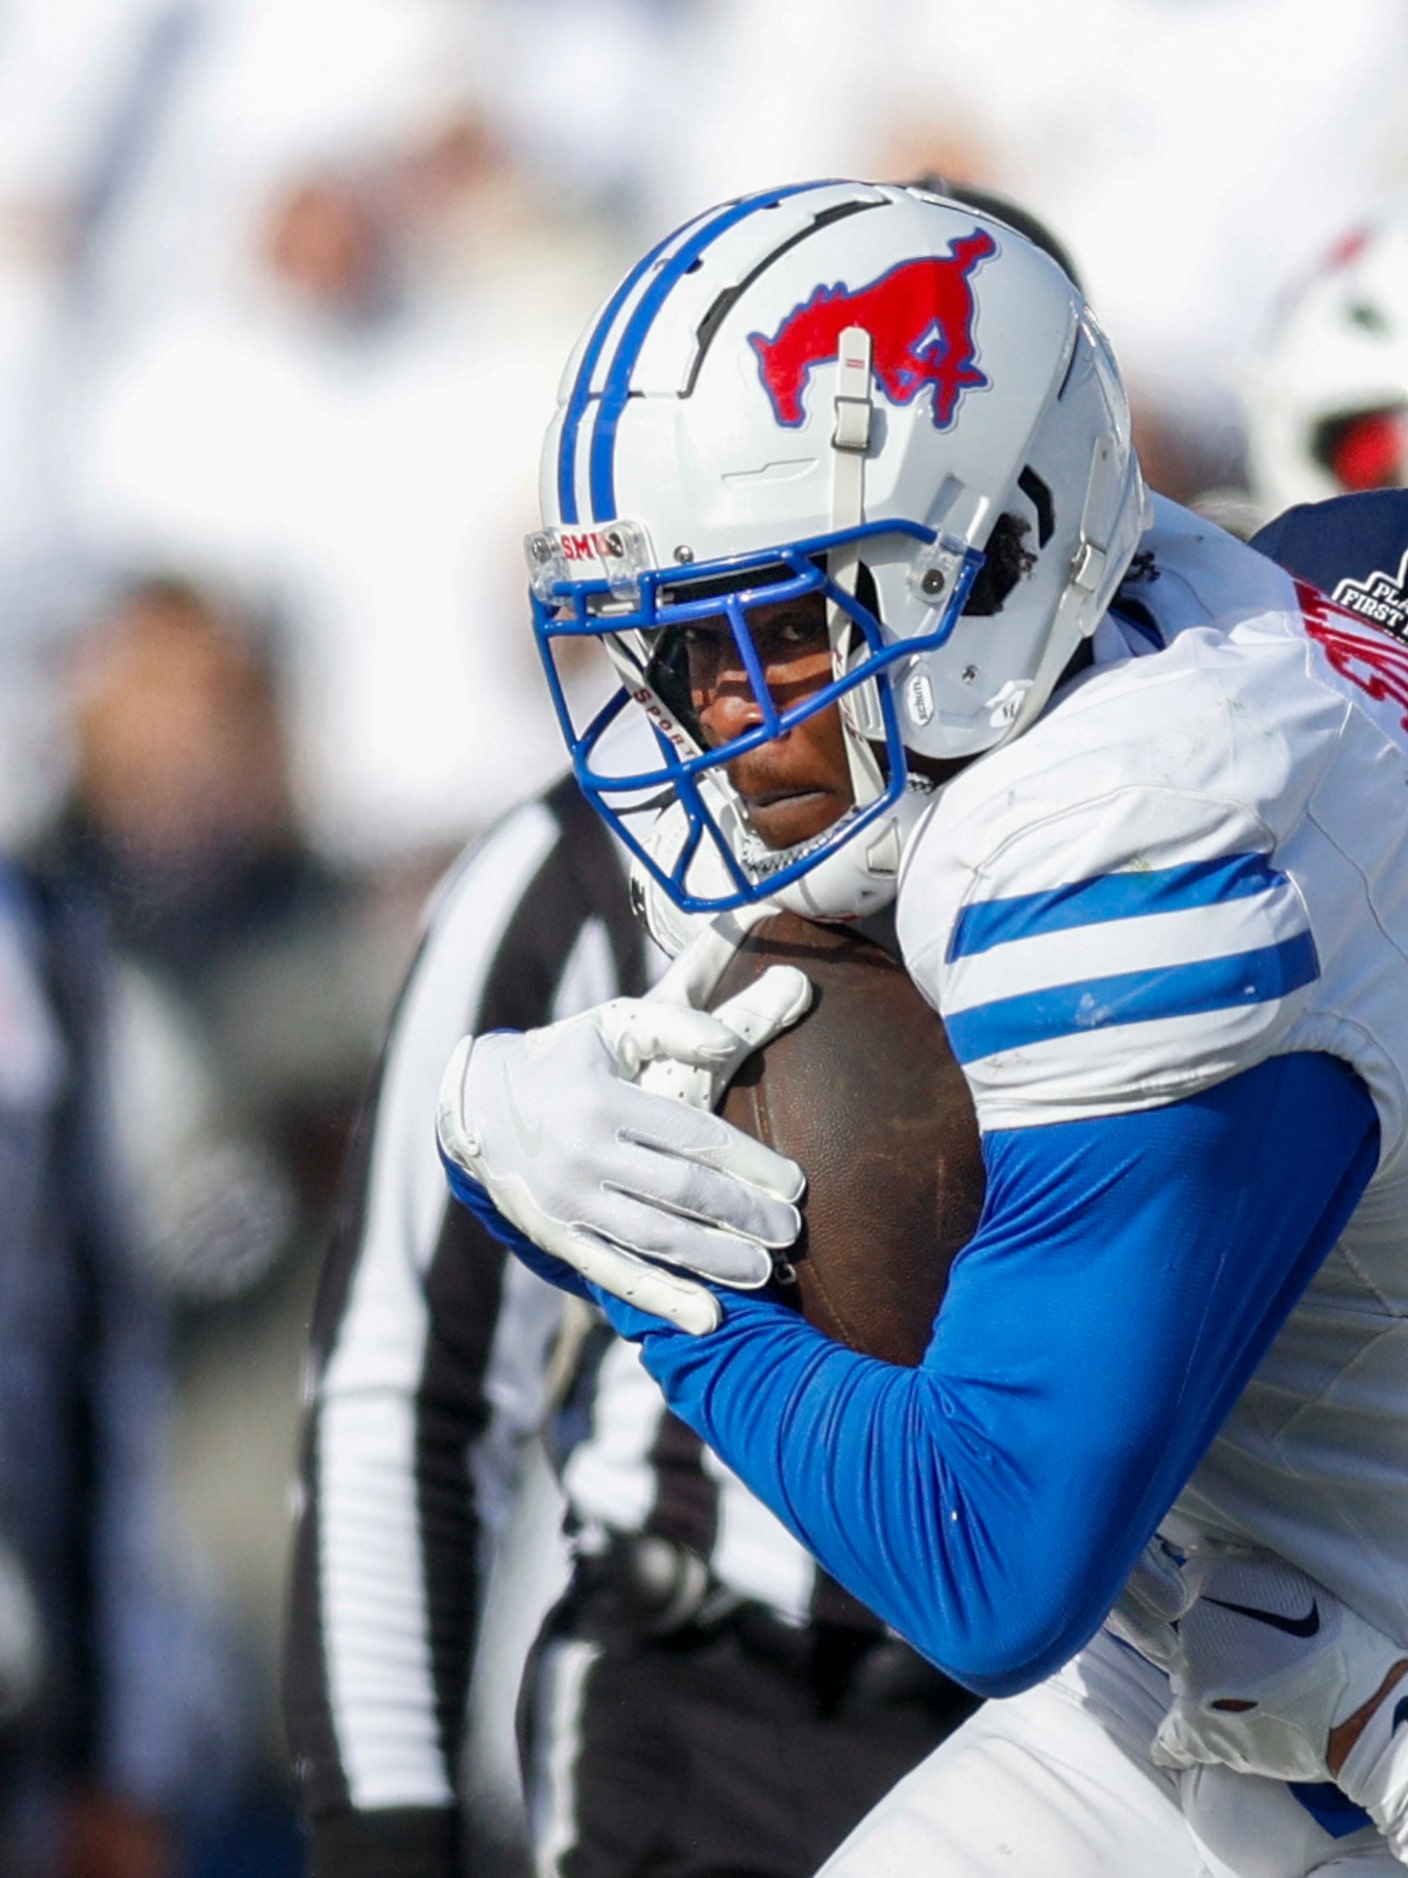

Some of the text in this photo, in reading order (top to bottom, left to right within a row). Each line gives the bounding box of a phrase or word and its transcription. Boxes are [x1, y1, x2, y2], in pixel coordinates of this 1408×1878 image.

[561, 533, 613, 560] SMU
[1340, 588, 1403, 627] FIRST
[633, 687, 697, 757] SPORT
